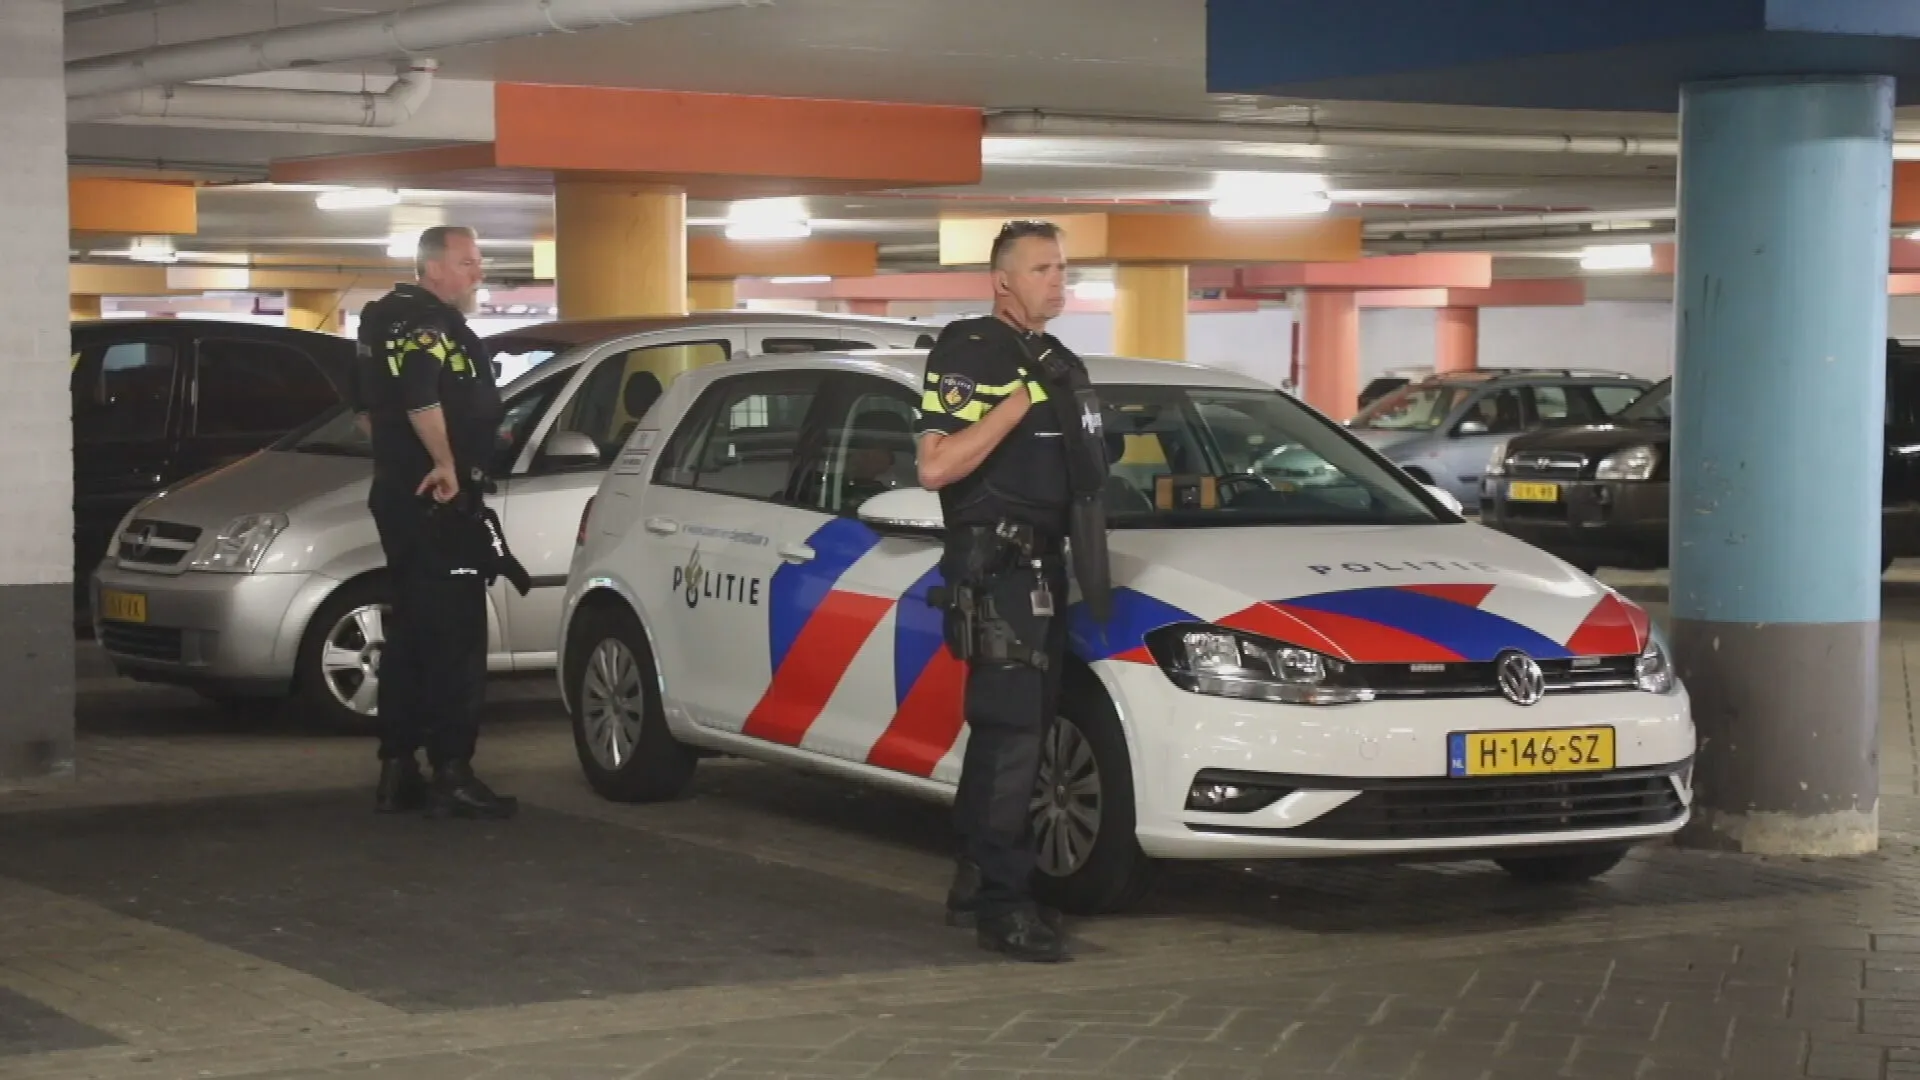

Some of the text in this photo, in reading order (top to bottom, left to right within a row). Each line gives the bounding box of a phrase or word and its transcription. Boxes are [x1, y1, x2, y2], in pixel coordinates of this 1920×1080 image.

[1307, 561, 1498, 575] POLITIE
[672, 564, 761, 609] POLITIE
[1479, 734, 1600, 768] H-146-SZ
